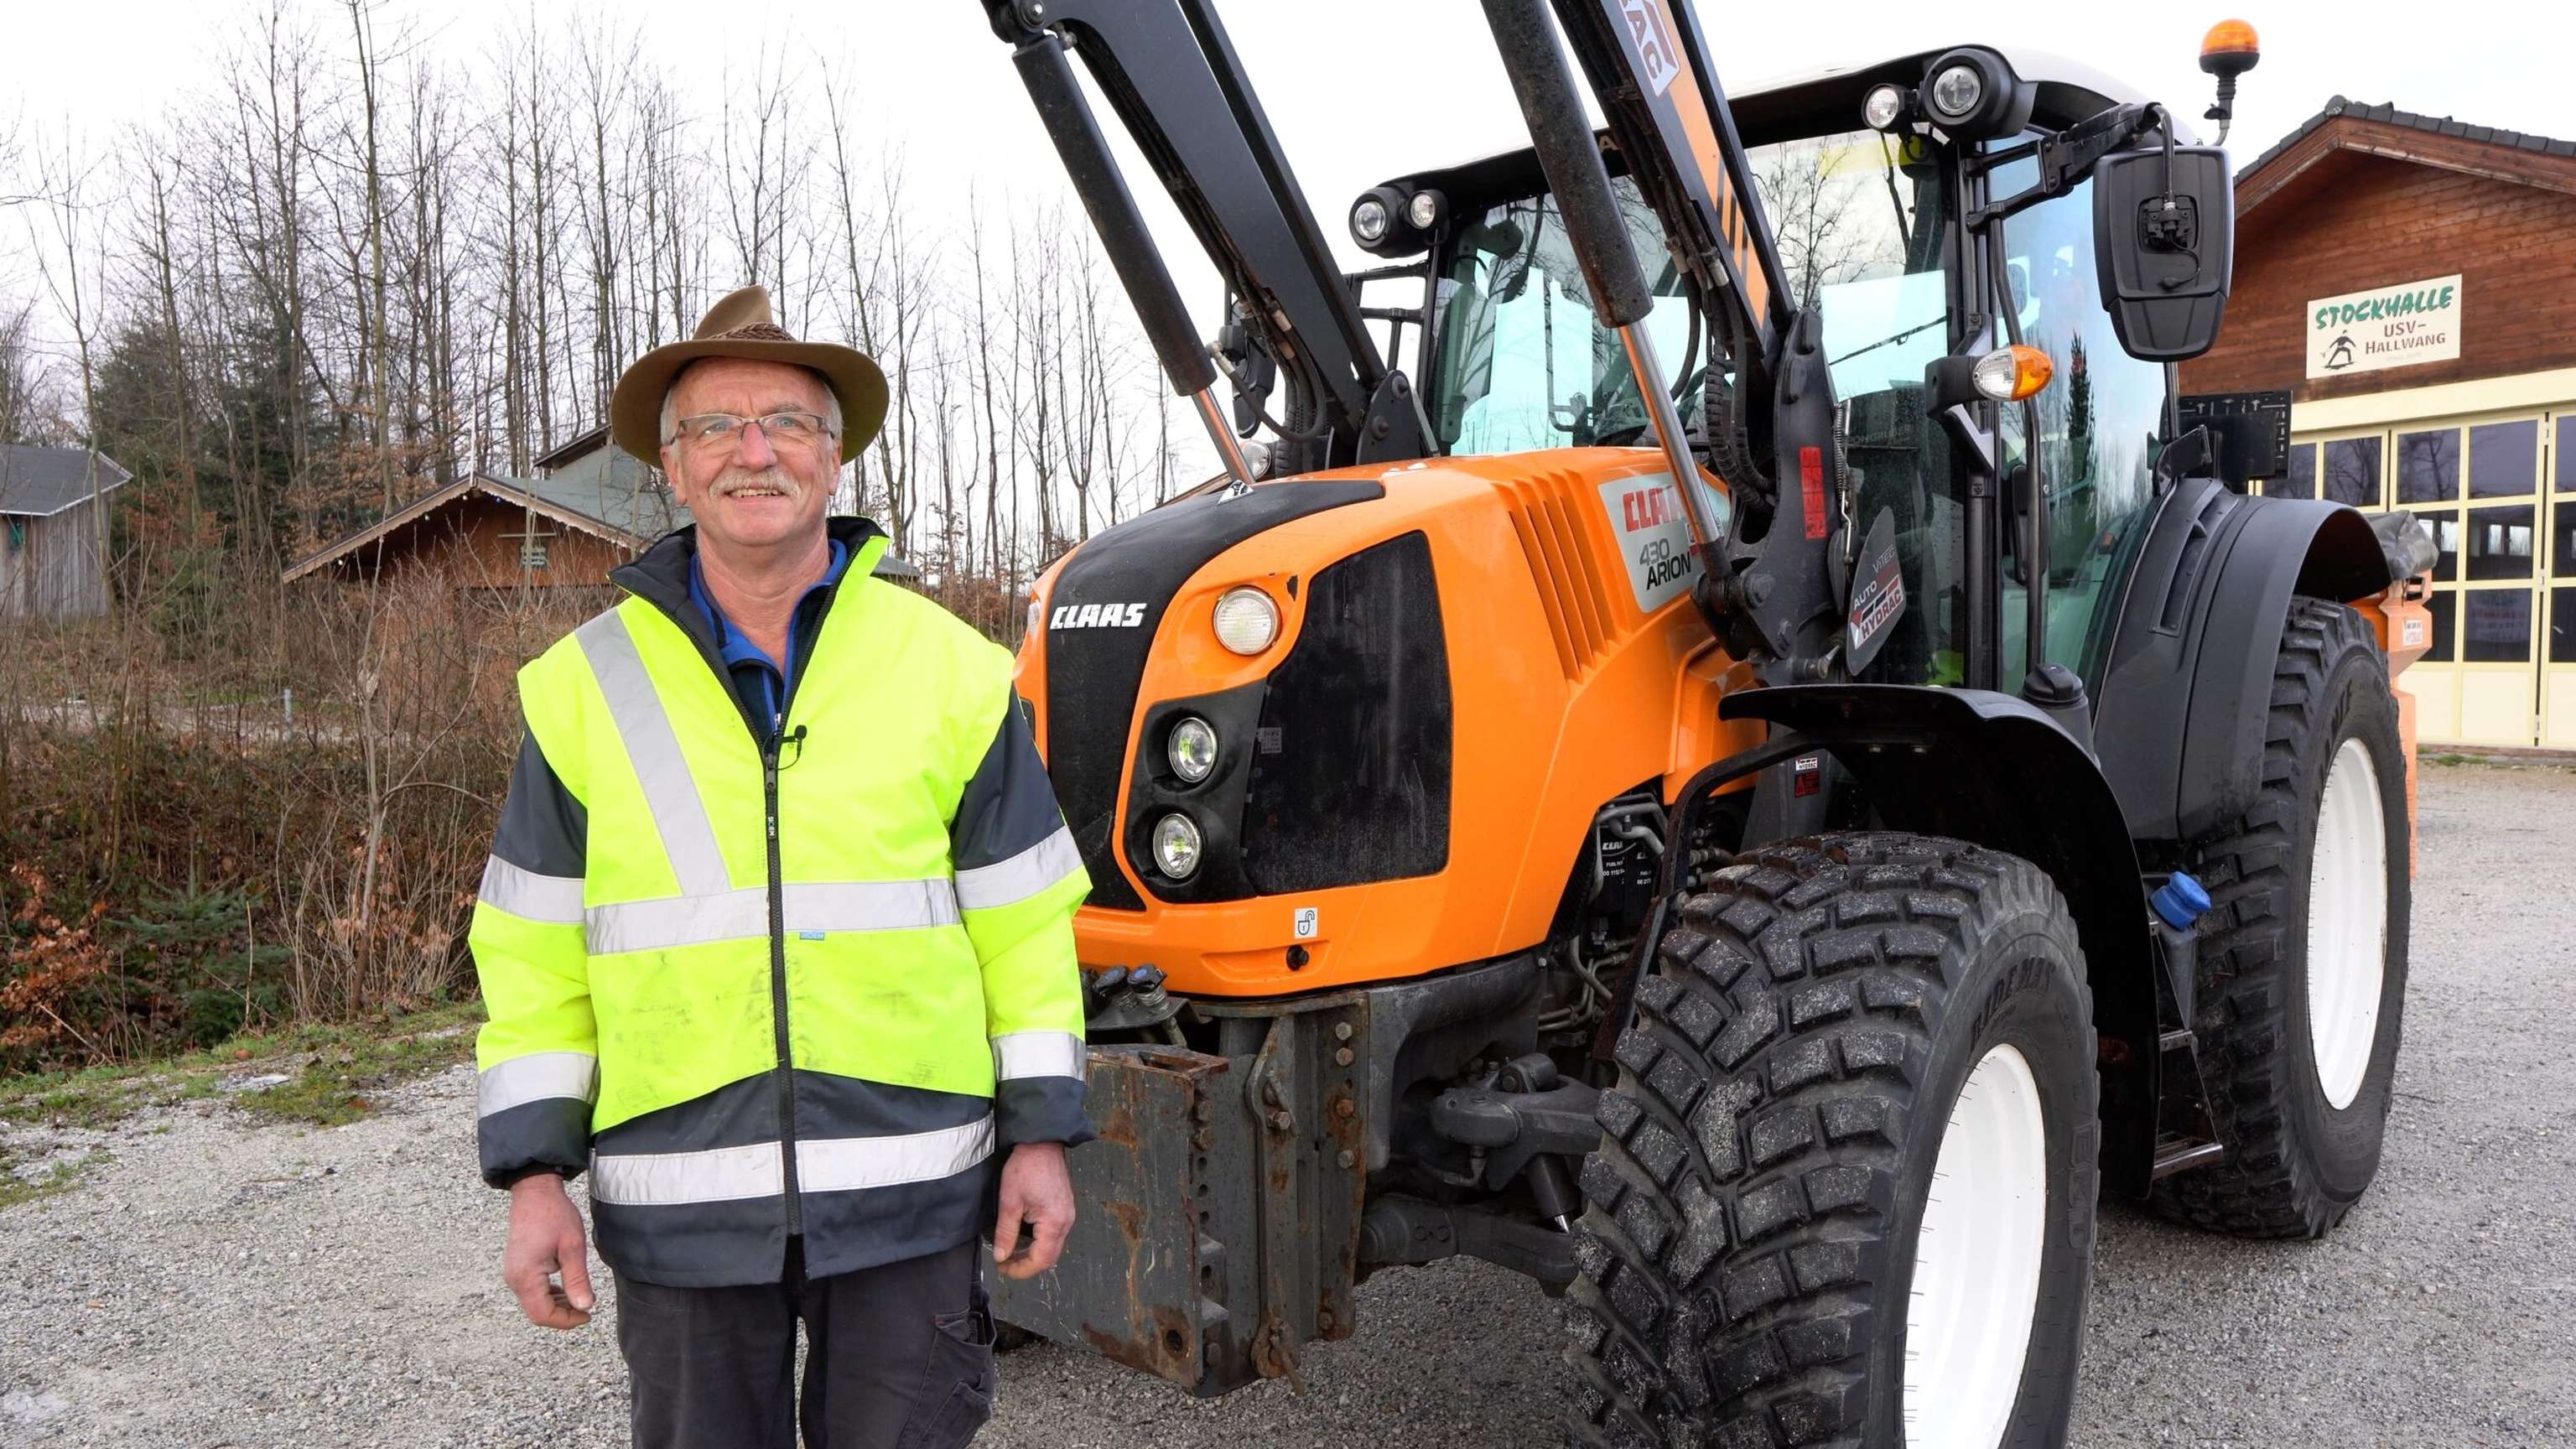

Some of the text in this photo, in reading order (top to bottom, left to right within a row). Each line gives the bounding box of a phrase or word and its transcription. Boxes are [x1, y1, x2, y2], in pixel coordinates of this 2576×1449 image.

[2315, 286, 2454, 330] STOCKHALLE
[2384, 320, 2427, 338] USV-
[2365, 333, 2446, 355] HALLWANG
[1639, 538, 1670, 566] 430
[1646, 551, 1691, 590] ARION
[1853, 580, 1878, 610] AUTO
[1049, 603, 1147, 630] CLAAS
[1861, 589, 1902, 640] HYDRAC
